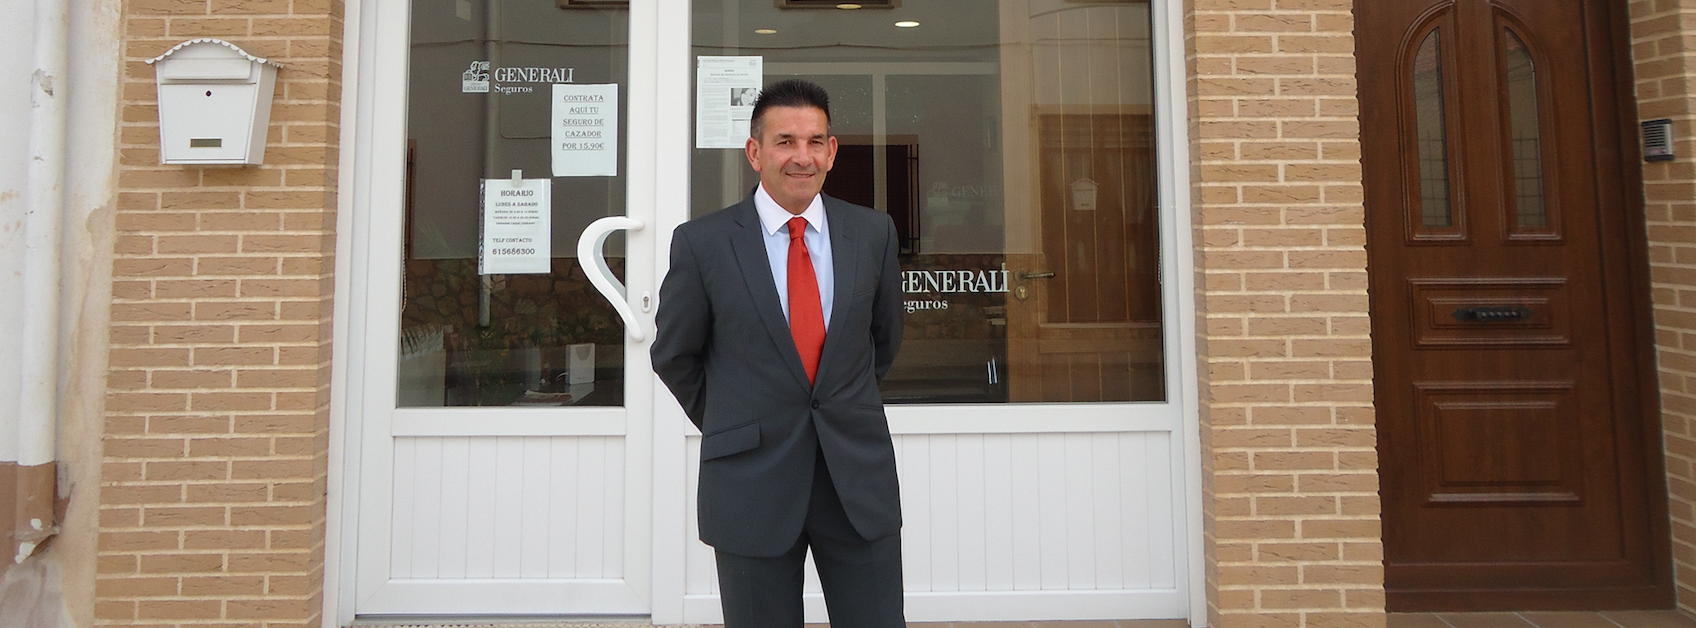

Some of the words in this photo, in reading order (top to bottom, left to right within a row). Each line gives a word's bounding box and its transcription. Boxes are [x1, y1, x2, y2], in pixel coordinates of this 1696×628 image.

[494, 67, 574, 83] GENERALI
[494, 84, 533, 95] Seguros
[569, 105, 588, 114] AQUÍ
[492, 247, 535, 255] 615686300
[901, 269, 1011, 293] ENERALI
